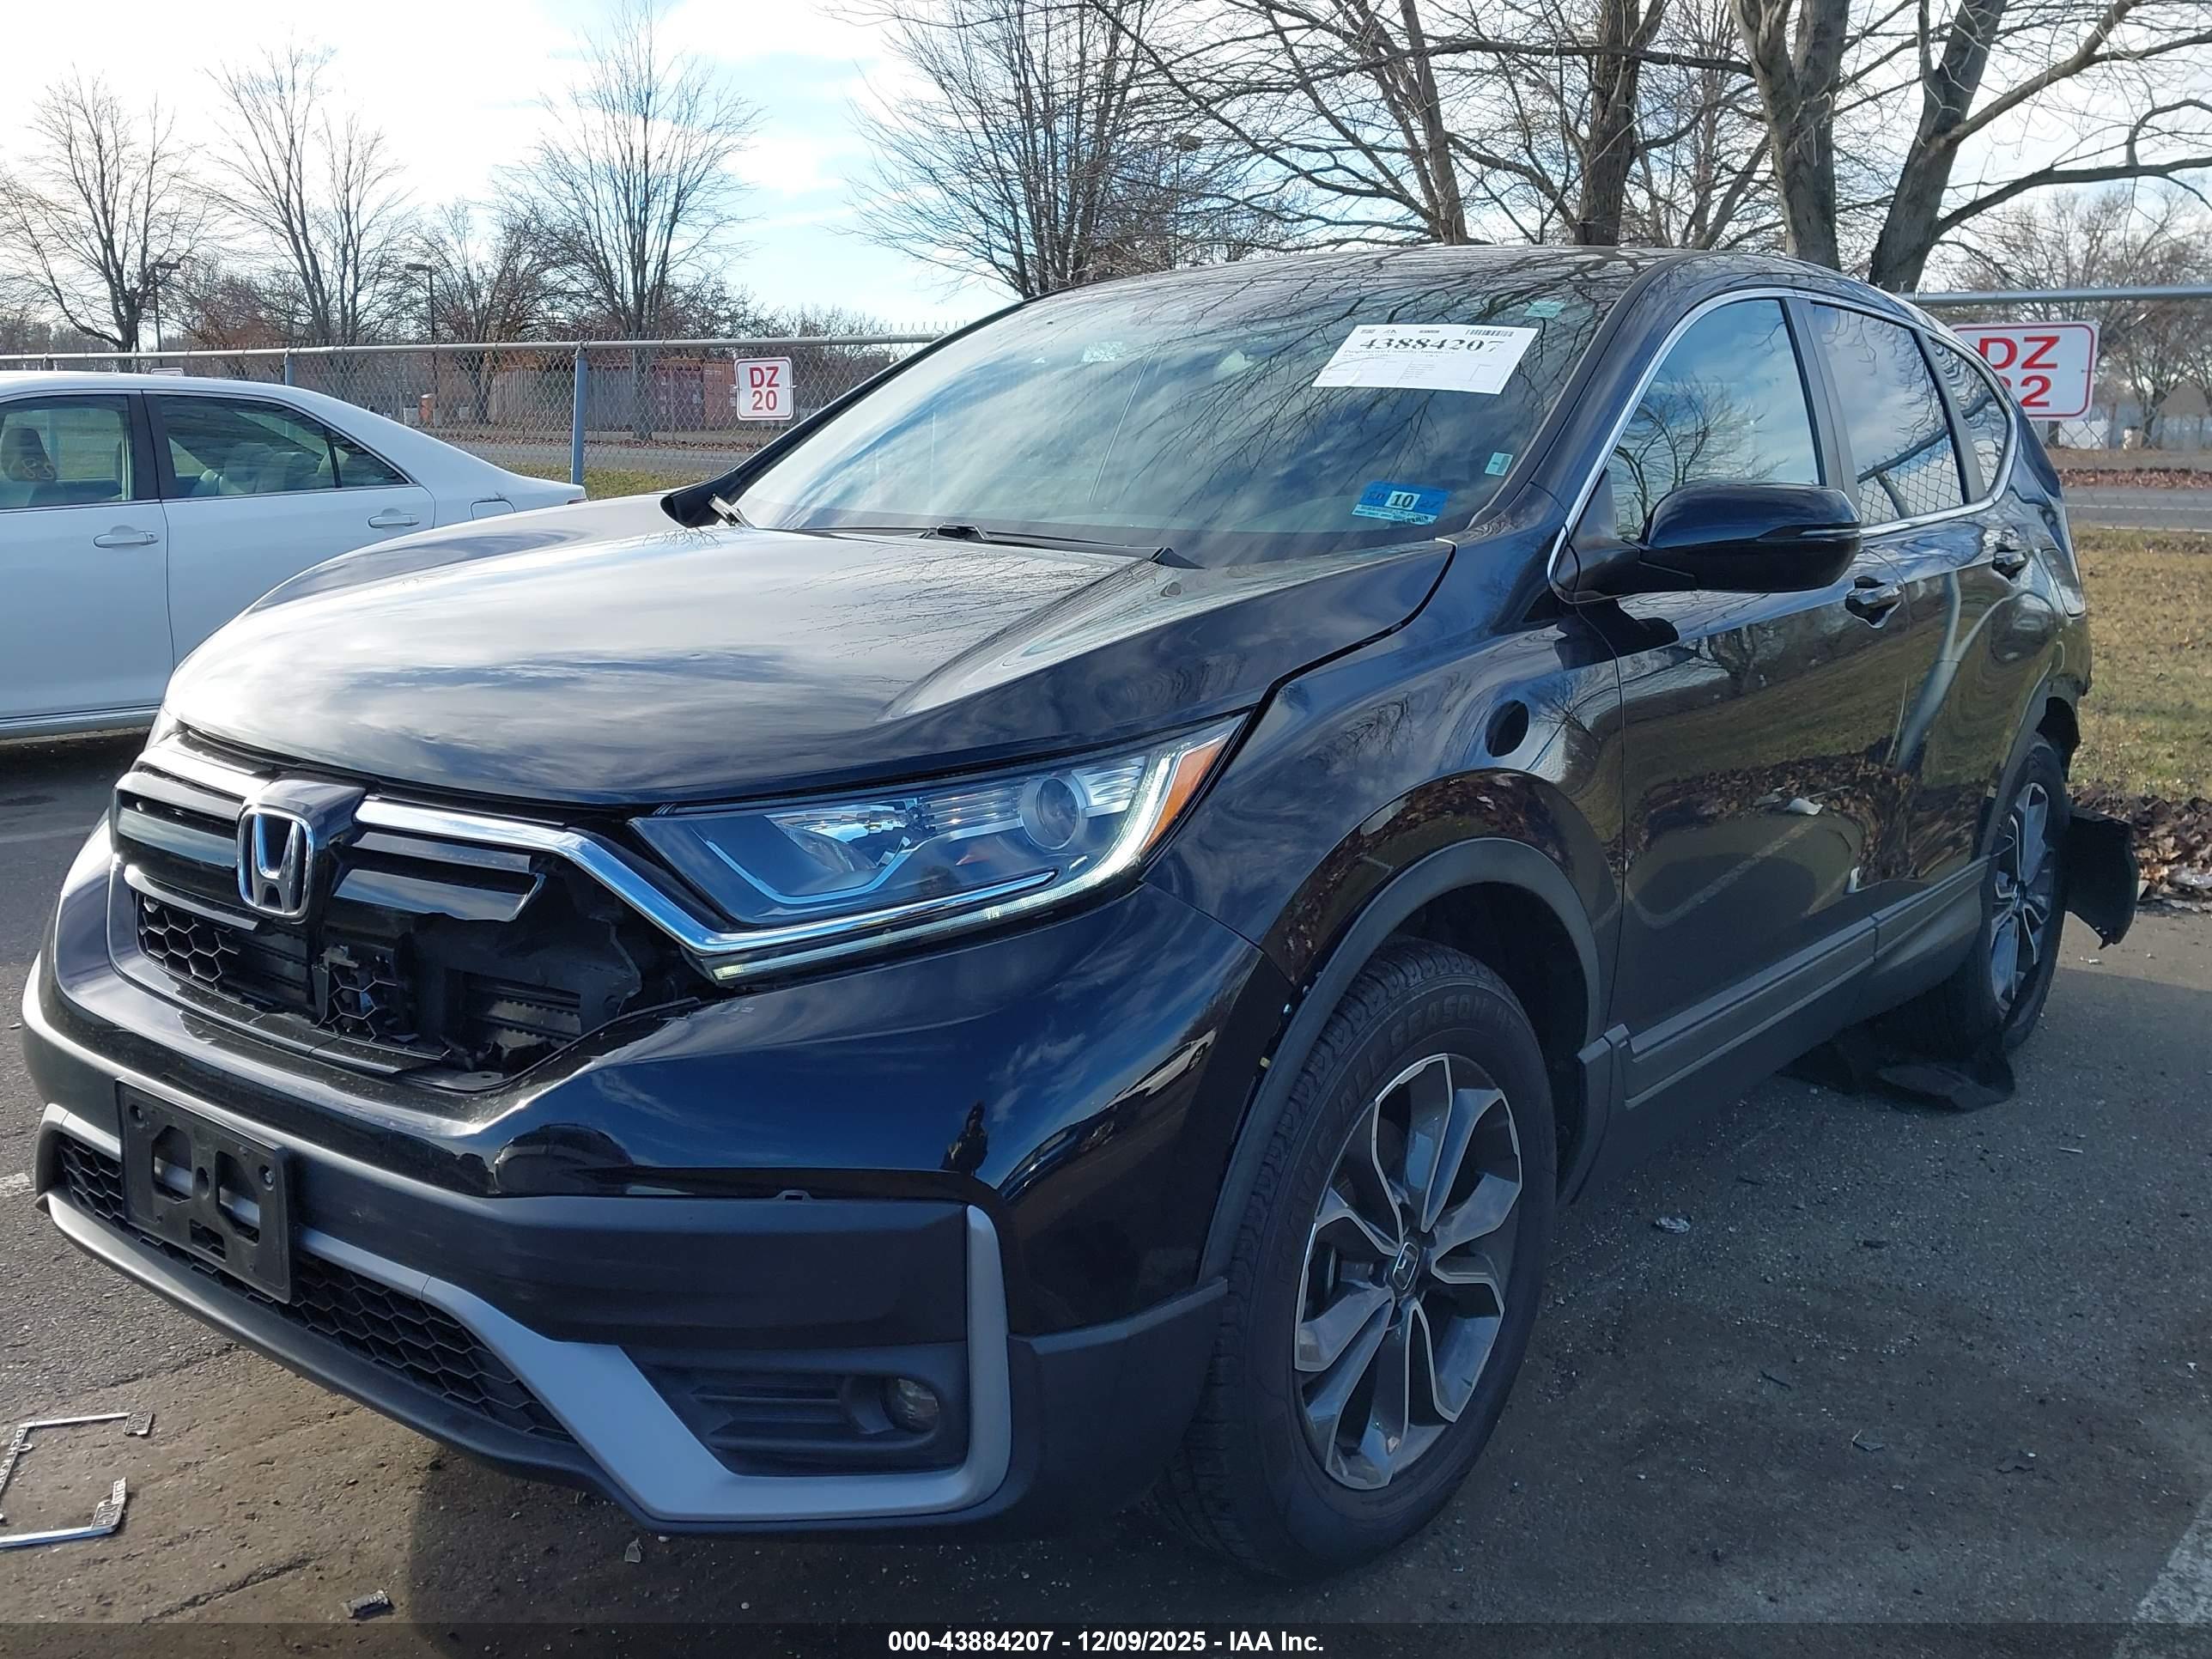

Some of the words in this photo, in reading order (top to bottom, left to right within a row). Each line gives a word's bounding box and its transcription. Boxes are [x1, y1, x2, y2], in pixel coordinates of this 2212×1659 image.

[1359, 337, 1505, 353] 43884207
[1978, 336, 2060, 370] DZ
[749, 366, 780, 388] DZ
[751, 390, 778, 410] 20
[2000, 374, 2051, 407] 2
[1391, 493, 1414, 508] 10
[1388, 994, 1489, 1048] SEASON
[6, 1429, 25, 1456] DCH
